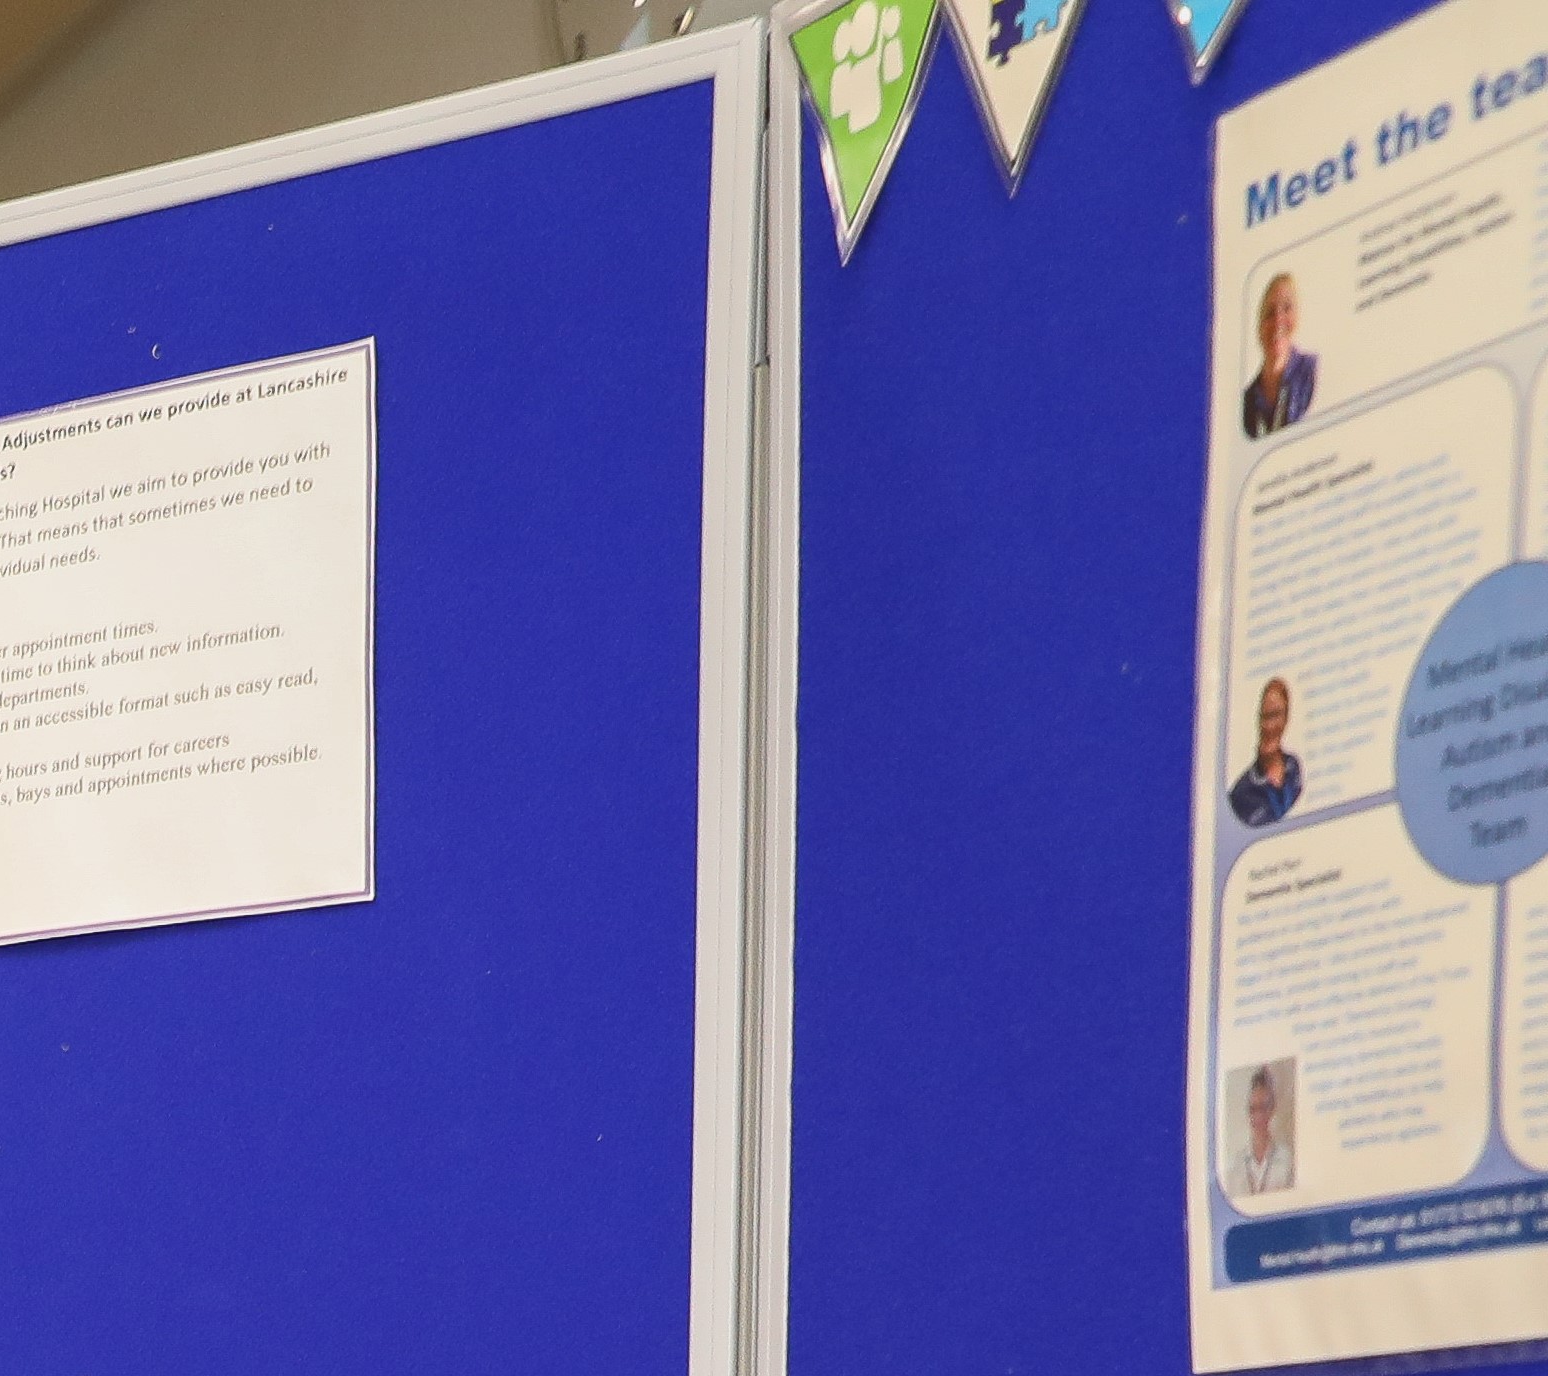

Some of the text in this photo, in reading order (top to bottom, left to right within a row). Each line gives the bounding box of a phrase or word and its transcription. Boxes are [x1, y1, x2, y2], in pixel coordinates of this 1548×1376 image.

[1246, 138, 1359, 229] Meet
[1376, 104, 1453, 167] the
[1, 418, 102, 452] Adjustments
[106, 412, 134, 430] can
[138, 407, 163, 423] we
[167, 389, 231, 421] provide
[235, 385, 252, 404] at
[257, 369, 348, 399] Lancashire
